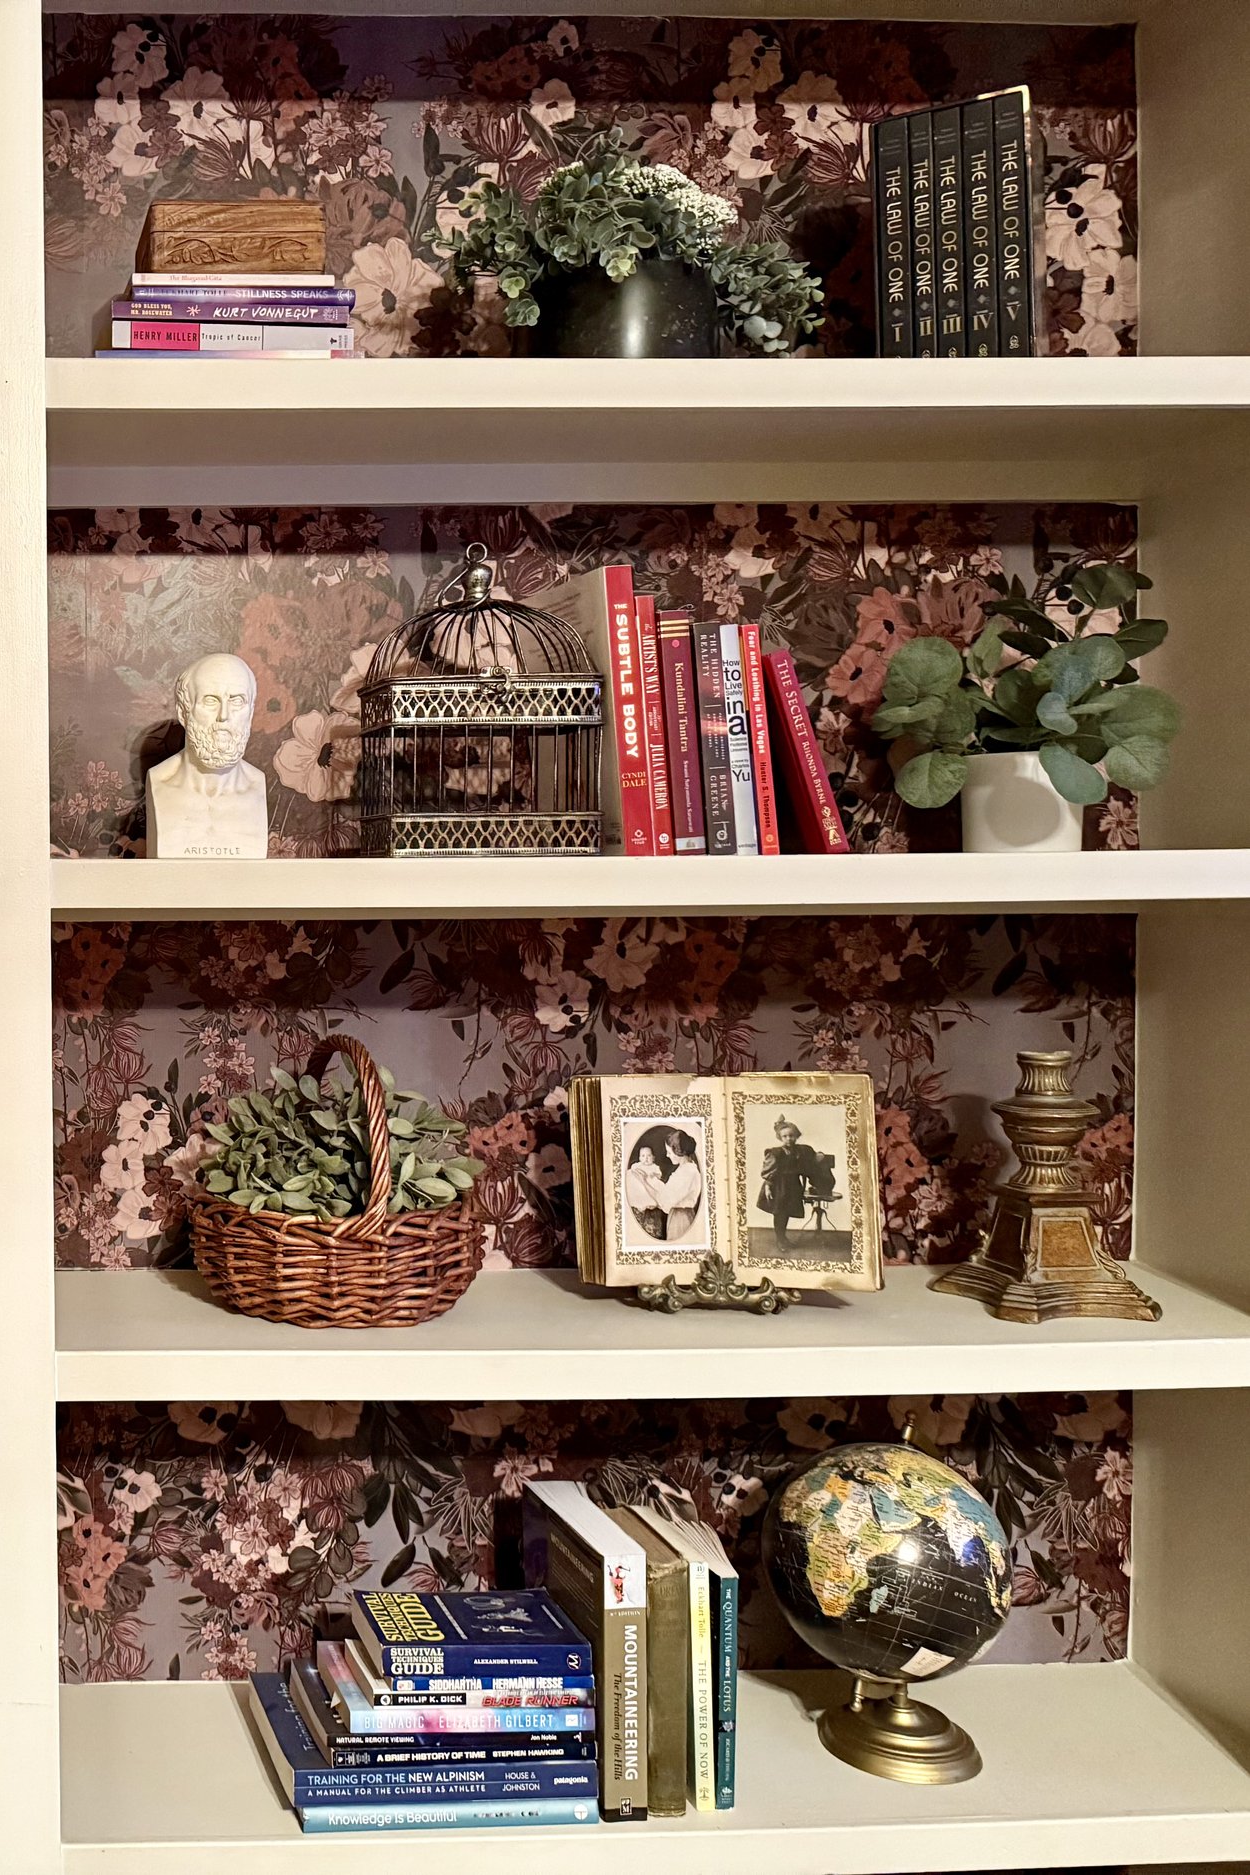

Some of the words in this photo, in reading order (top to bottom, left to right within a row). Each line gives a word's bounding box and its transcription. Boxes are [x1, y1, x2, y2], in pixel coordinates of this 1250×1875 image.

[971, 150, 987, 182] THE
[1001, 140, 1018, 172] THE
[886, 166, 901, 197] THE
[913, 159, 928, 190] THE
[940, 155, 956, 187] THE
[972, 186, 988, 221] LAW
[1002, 176, 1019, 211] LAW
[887, 201, 902, 235] LAW
[914, 194, 930, 228] LAW
[941, 191, 956, 225] LAW
[973, 226, 988, 248] OF
[1003, 216, 1019, 238] OF
[888, 240, 903, 262] OF
[915, 233, 930, 255] OF
[941, 230, 957, 252] OF
[973, 253, 989, 289] ONE
[1004, 244, 1020, 280] ONE
[888, 267, 904, 303] ONE
[916, 260, 931, 296] ONE
[942, 258, 958, 293] ONE
[235, 290, 287, 298] STILLNESS
[291, 290, 329, 298] SPEAKS
[213, 306, 248, 318] KURT
[252, 306, 318, 320] VONNEGUT
[134, 331, 161, 341] HENRY
[166, 332, 198, 342] MILLER
[202, 333, 223, 341] Tropic
[616, 614, 634, 695] SUBTLE
[700, 634, 710, 677] REALITY
[645, 675, 660, 694] WAY
[723, 667, 741, 681] to
[725, 682, 742, 690] Live
[726, 697, 744, 715] in
[623, 704, 639, 758] BODY
[728, 715, 746, 736] a
[776, 660, 792, 686] THE
[785, 690, 808, 737] SECRET
[802, 740, 817, 780] RHONDA
[813, 778, 827, 805] BYRNE
[650, 743, 666, 767] JULIA
[621, 771, 646, 780] CYNDI
[622, 779, 647, 788] DALE
[732, 769, 750, 782] Yu
[653, 770, 669, 810] CAMERON
[710, 775, 720, 817] GREENE
[183, 846, 241, 856] ARISTOTLE
[392, 1593, 445, 1641] GUIDE
[698, 1617, 706, 1638] Tolle
[390, 1648, 444, 1656] SURVIVAL
[391, 1663, 444, 1674] GUIDE
[698, 1661, 706, 1684] THE
[428, 1677, 482, 1691] SIDDHARTHA
[492, 1677, 536, 1689] HERMANN
[536, 1677, 563, 1689] HESSE
[613, 1673, 622, 1691] The
[398, 1696, 427, 1704] PHILIP
[440, 1695, 463, 1703] DICK
[482, 1696, 522, 1707] BLADE
[525, 1695, 579, 1706] RUNNER
[613, 1692, 623, 1731] Freedom
[624, 1624, 638, 1781] MOUNTAINEERING
[699, 1689, 708, 1730] POWER
[364, 1716, 383, 1729] BIG
[390, 1715, 425, 1729] MAGIC
[438, 1714, 501, 1729] ELIZABETH
[505, 1714, 553, 1728] GILBERT
[611, 1733, 622, 1746] of
[700, 1735, 708, 1749] OF
[385, 1753, 410, 1762] BRIEF
[412, 1752, 450, 1761] HISTORY
[451, 1752, 463, 1760] OF
[464, 1751, 486, 1759] TIME
[492, 1749, 527, 1757] STEPHEN
[528, 1748, 564, 1756] HAWKING
[614, 1746, 623, 1758] the
[614, 1759, 623, 1781] Hills
[700, 1752, 709, 1779] NOW
[308, 1774, 358, 1785] TRAINING
[361, 1773, 383, 1784] FOR
[385, 1773, 406, 1784] THE
[408, 1772, 433, 1783] NEW
[435, 1771, 485, 1783] ALPINISM
[505, 1772, 529, 1780] HOUSE
[553, 1776, 589, 1786] patagonia
[316, 1788, 351, 1796] MANUAL
[375, 1787, 391, 1795] THE
[394, 1786, 432, 1794] CLIMBER
[449, 1784, 486, 1793] ATHLETE
[502, 1783, 540, 1792] JOHNSTON
[328, 1812, 393, 1827] Knowledge
[407, 1810, 457, 1823] Beautiful
